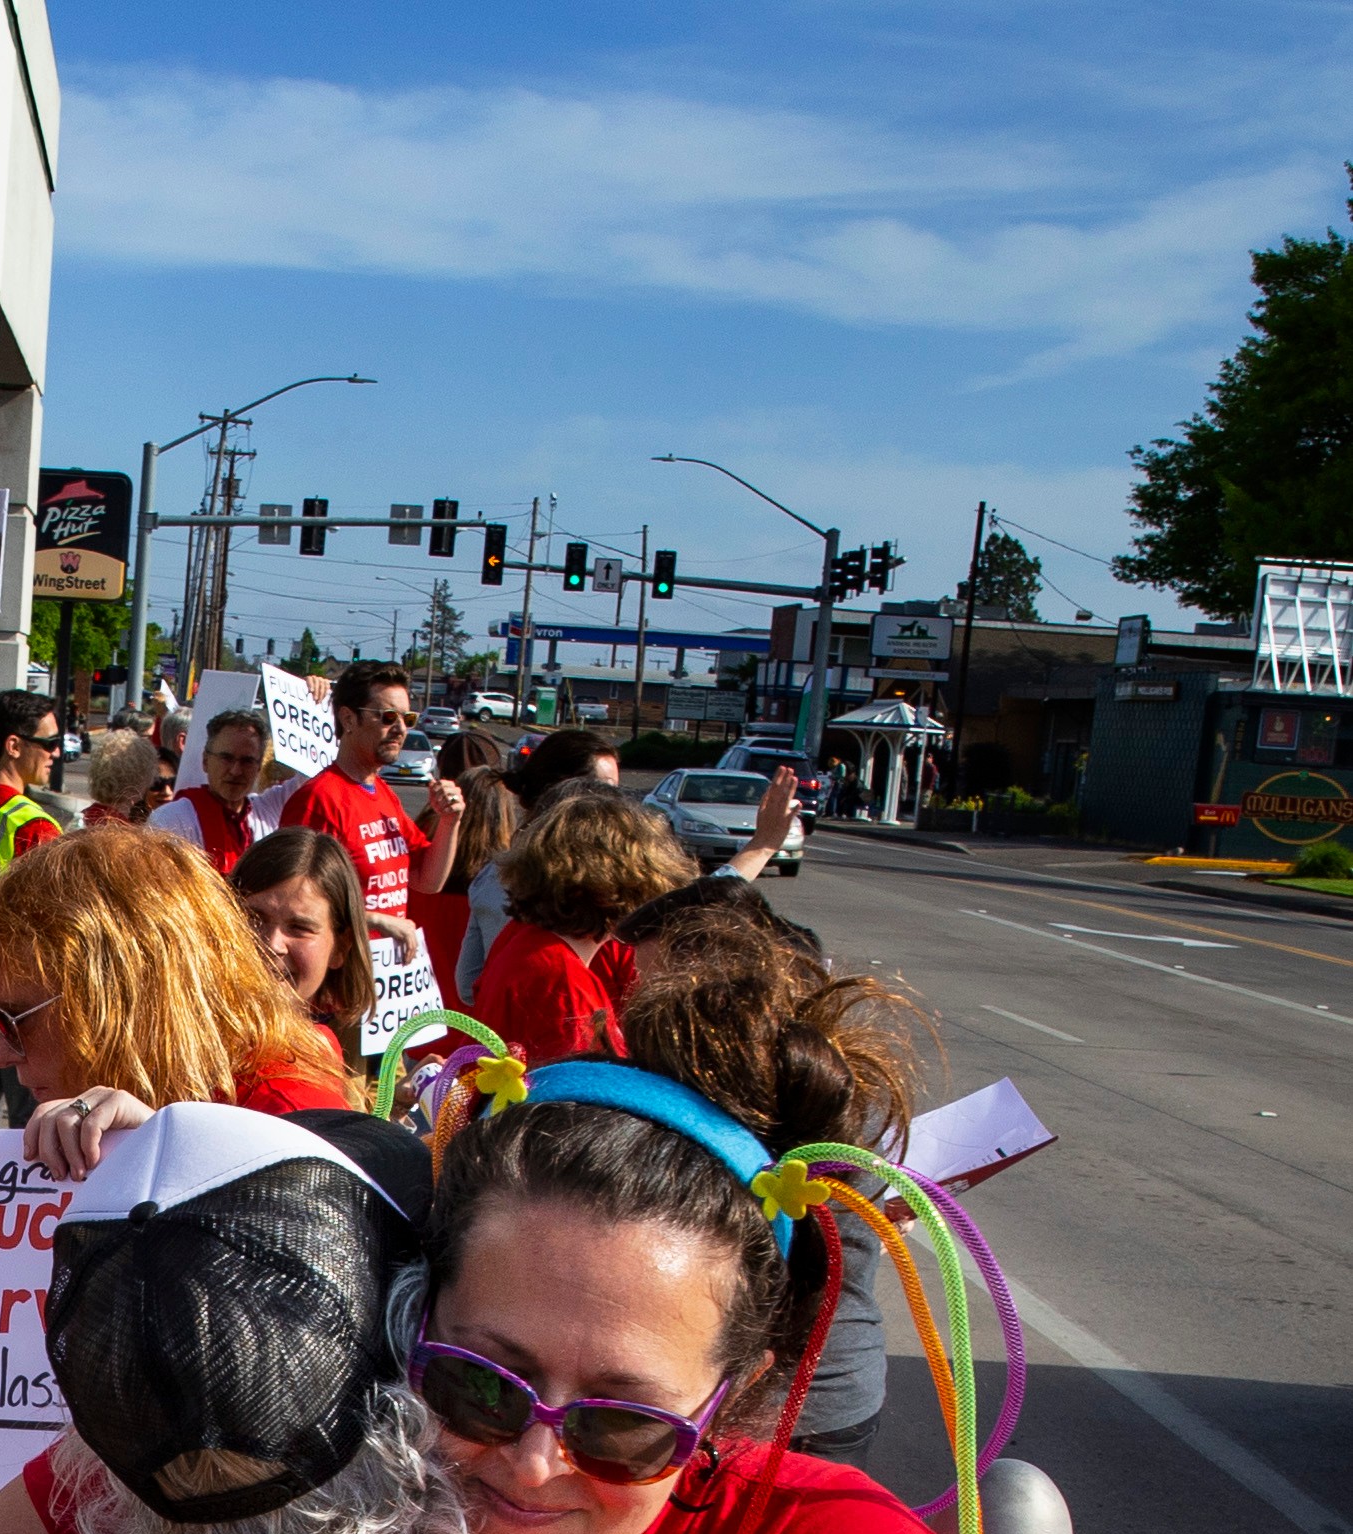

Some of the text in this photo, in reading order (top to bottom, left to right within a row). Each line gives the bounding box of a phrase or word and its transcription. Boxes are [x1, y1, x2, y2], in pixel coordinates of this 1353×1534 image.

[41, 500, 106, 534] Pizza
[53, 519, 100, 540] Hut
[33, 574, 107, 592] WingStreet
[273, 698, 338, 746] OREGO
[1246, 794, 1353, 818] MULLIGANS
